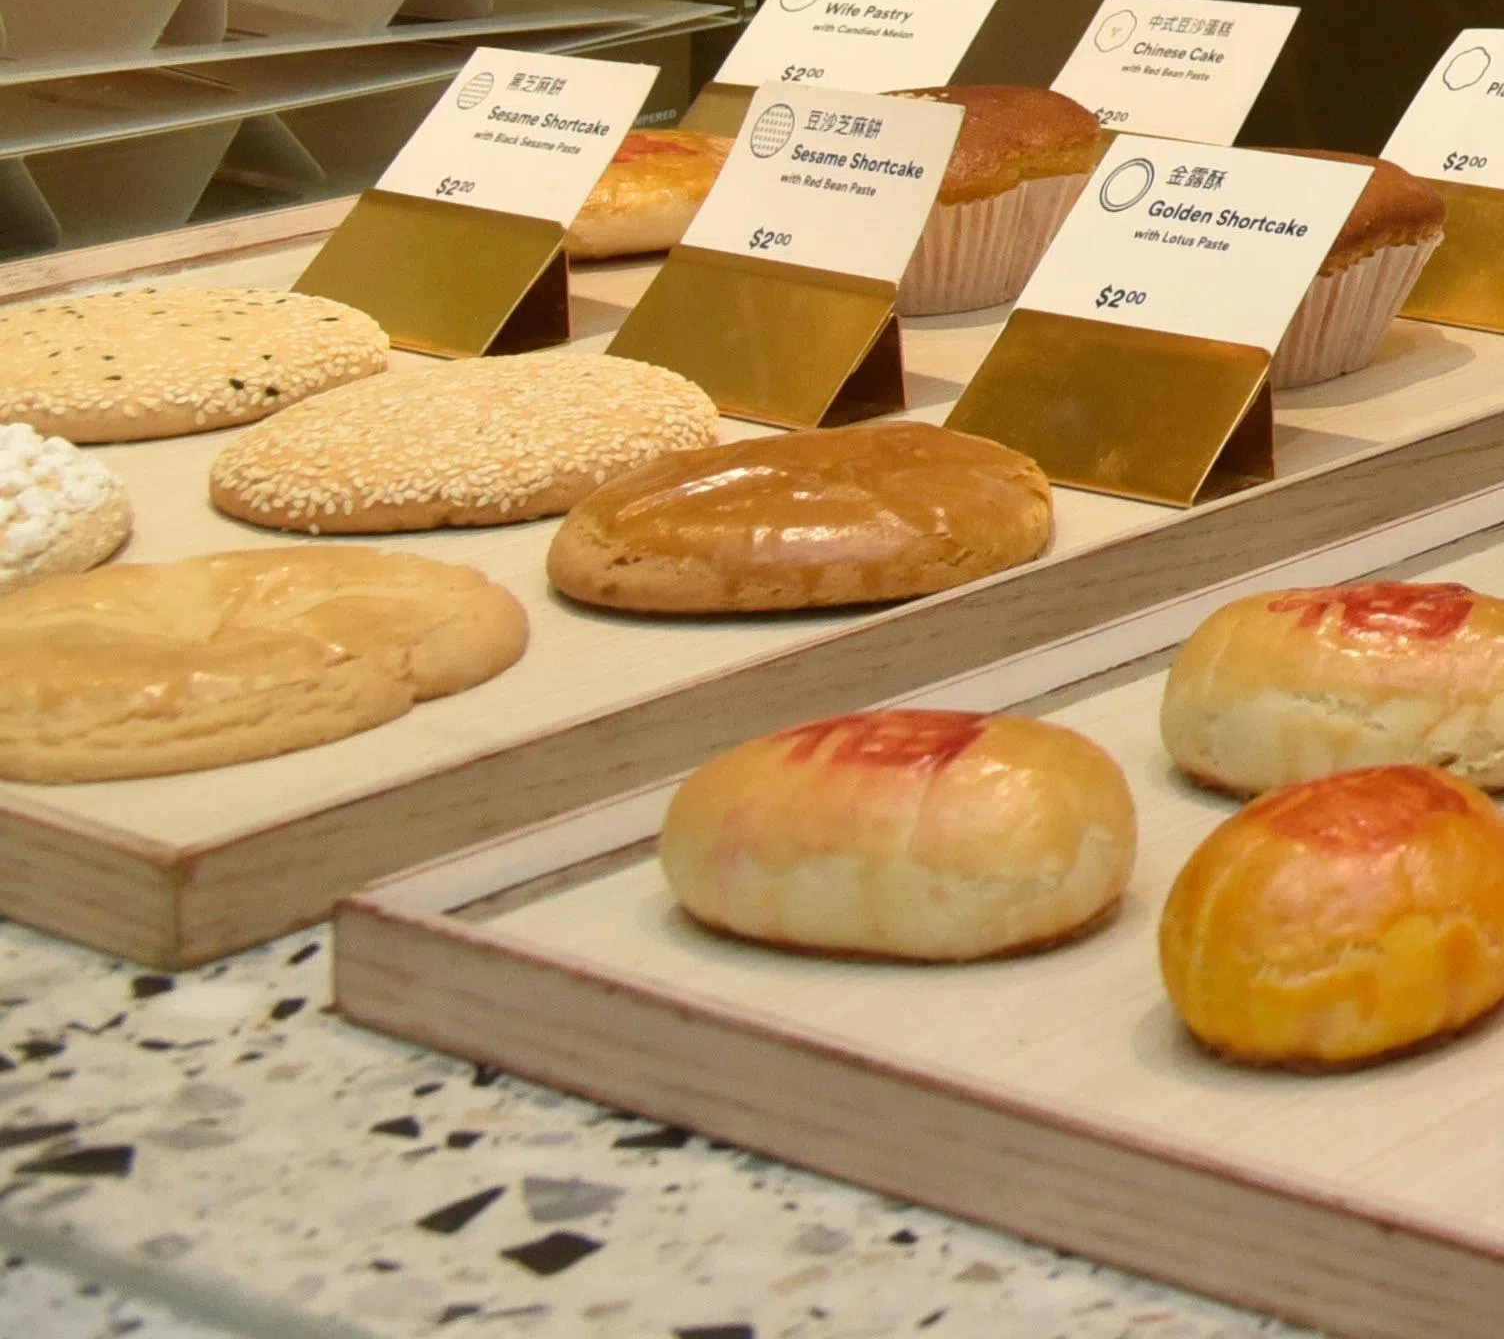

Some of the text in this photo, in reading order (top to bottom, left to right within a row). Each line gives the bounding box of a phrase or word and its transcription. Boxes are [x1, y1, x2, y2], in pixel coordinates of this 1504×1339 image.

[825, 2, 913, 24] Wife Pastry
[812, 23, 914, 39] with Candied Melon
[1148, 14, 1235, 38] 中式豆沙蛋糕
[1132, 41, 1225, 64] Chinese Cake
[1121, 64, 1211, 82] with Red Bean Paste
[487, 105, 610, 137] Sesame Shortcake
[630, 109, 678, 126] MPERED
[803, 109, 884, 140] 豆沙芝麻餅
[473, 132, 582, 155] with Black Sesame Paste
[790, 143, 925, 180] Sesame Shortcake
[780, 173, 877, 197] with Red Bean Paste
[1165, 164, 1229, 191] 金露酥
[1148, 199, 1309, 238] Golden Shortcake
[1133, 229, 1230, 252] with Lotus Paste
